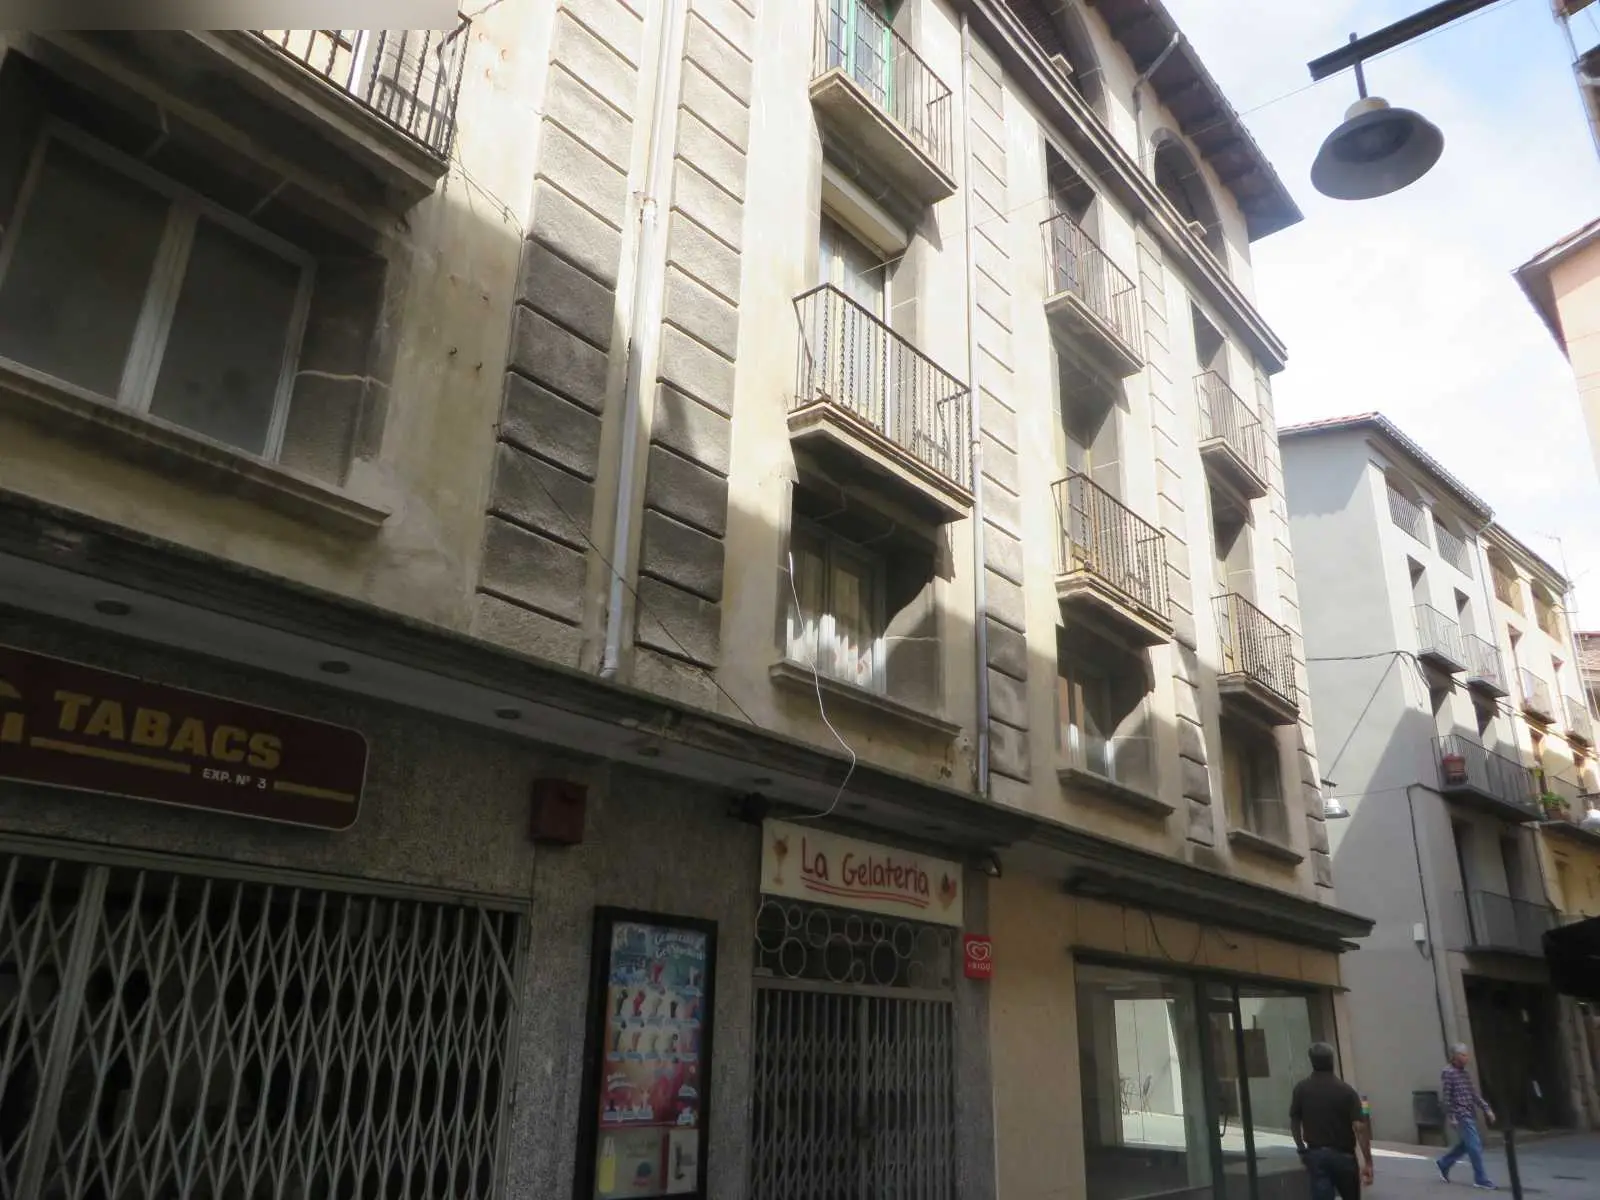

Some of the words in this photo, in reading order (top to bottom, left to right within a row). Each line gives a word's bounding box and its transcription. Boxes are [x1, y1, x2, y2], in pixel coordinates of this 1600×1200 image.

[54, 690, 283, 769] TABACS
[202, 768, 232, 783] EXP.
[257, 777, 267, 789] 3
[802, 836, 829, 880] La
[842, 853, 929, 897] Gelateria
